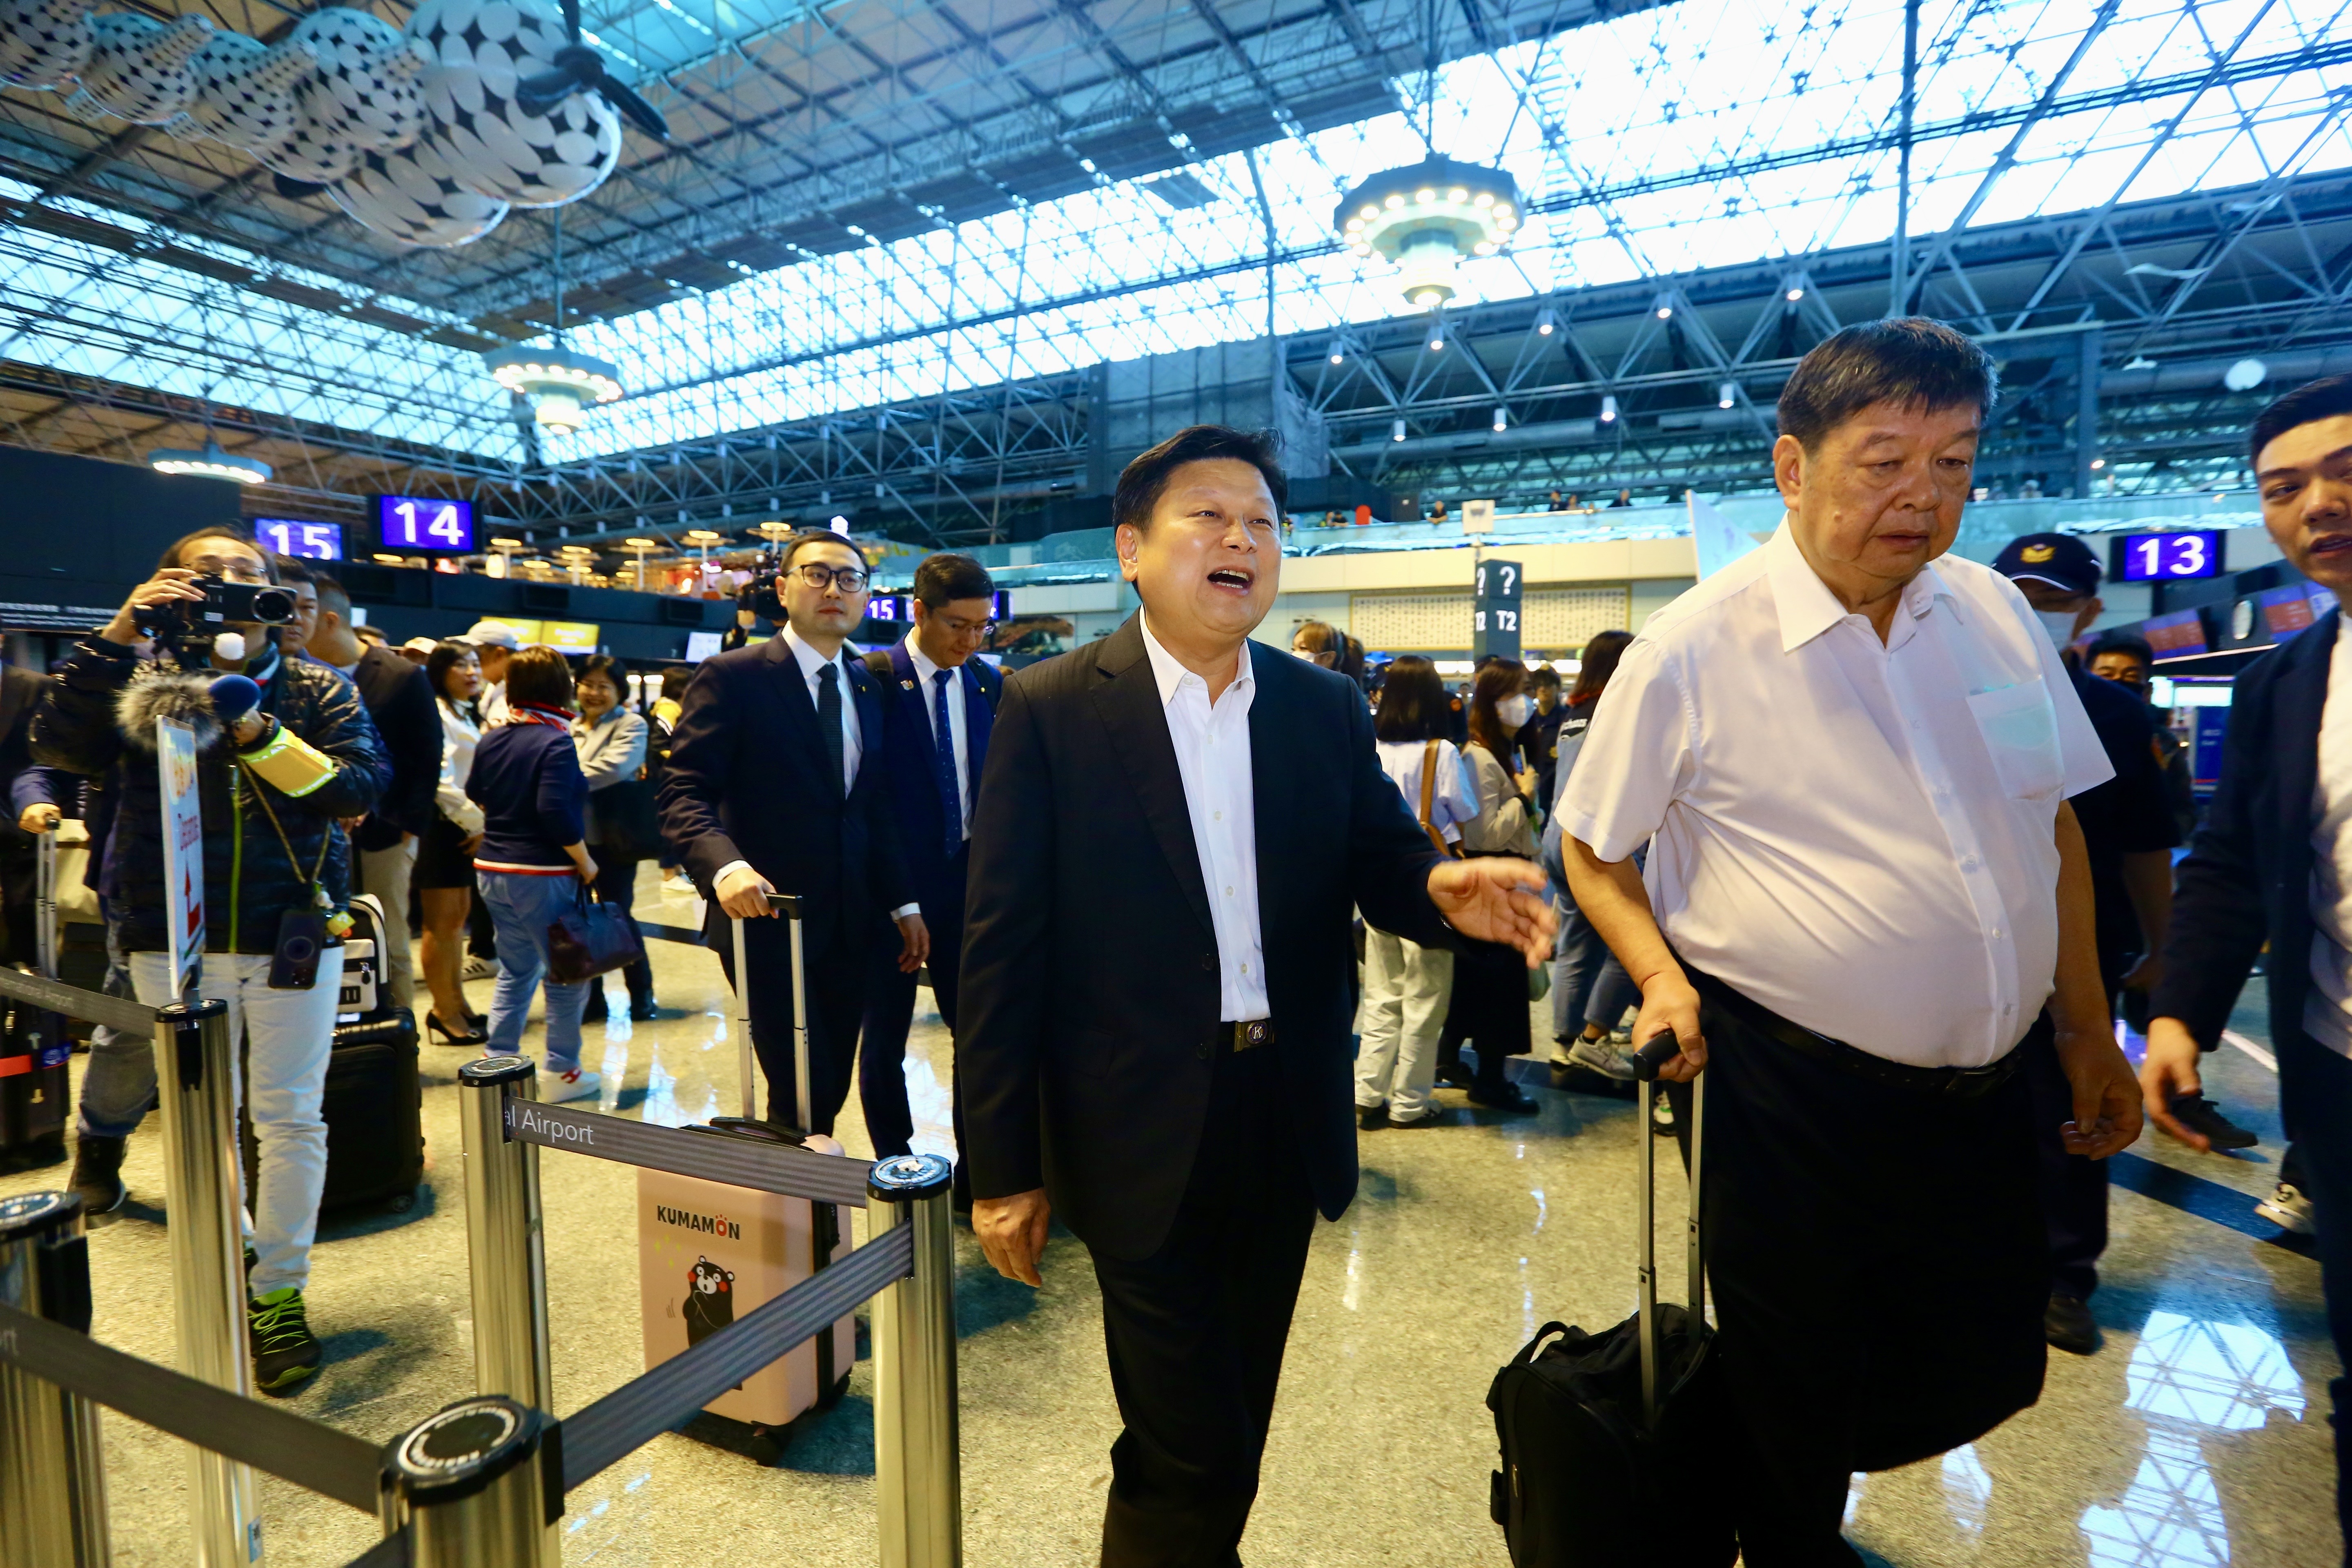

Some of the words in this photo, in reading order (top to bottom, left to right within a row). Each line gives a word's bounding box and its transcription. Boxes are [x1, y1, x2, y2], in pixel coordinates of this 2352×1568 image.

[269, 524, 333, 560] 15
[394, 502, 465, 546] 14
[2136, 535, 2205, 575] 13
[869, 599, 894, 621] 15
[1496, 610, 1517, 632] T2
[521, 1109, 595, 1145] Airport
